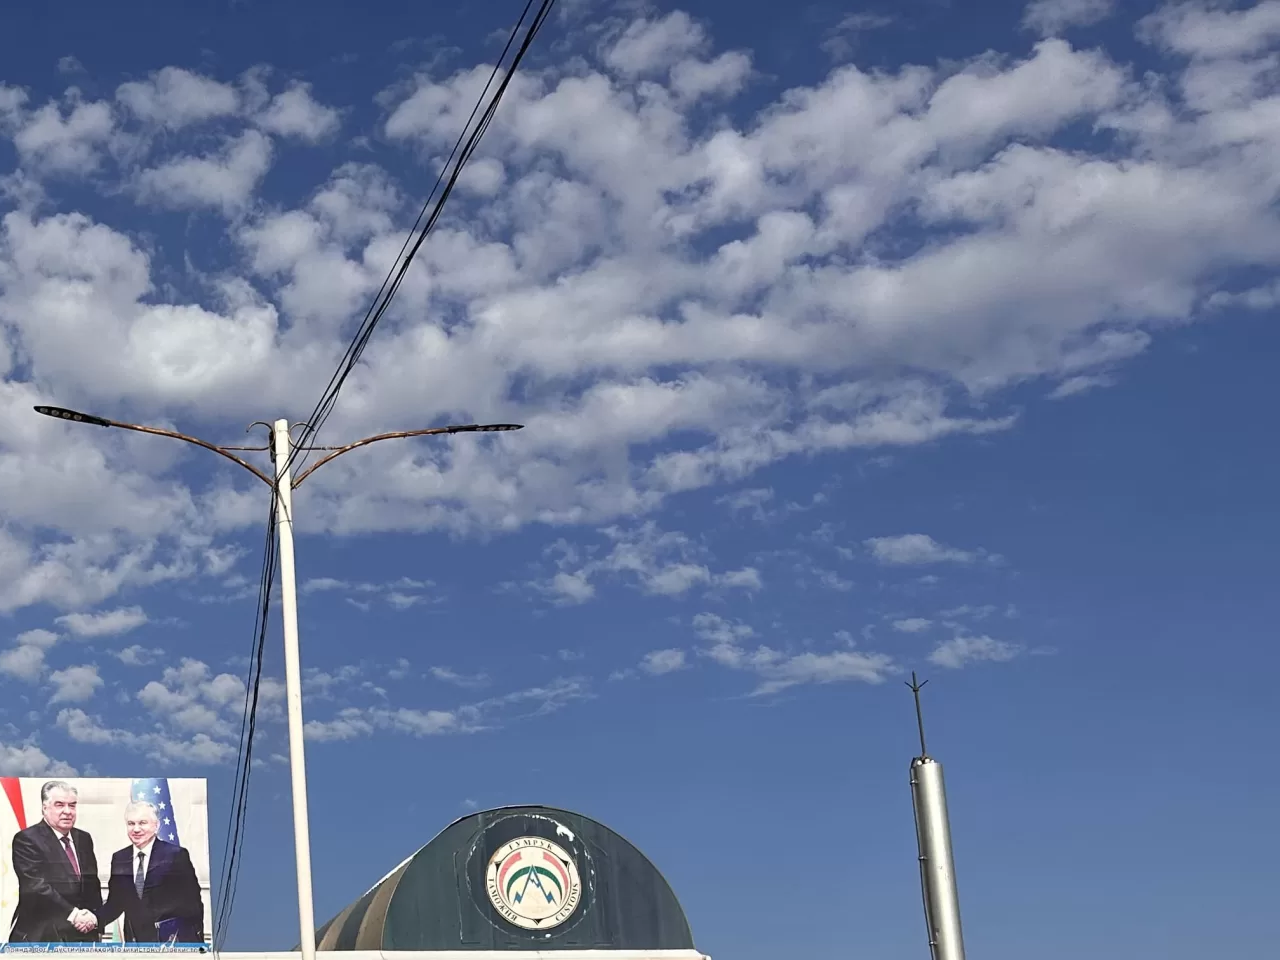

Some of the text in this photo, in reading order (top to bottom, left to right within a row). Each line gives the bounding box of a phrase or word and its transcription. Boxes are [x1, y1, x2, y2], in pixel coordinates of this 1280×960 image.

[508, 839, 553, 851] ГУМРУК
[488, 878, 518, 922] ТАМОЖНЯ
[555, 883, 579, 922] CUSTOMS
